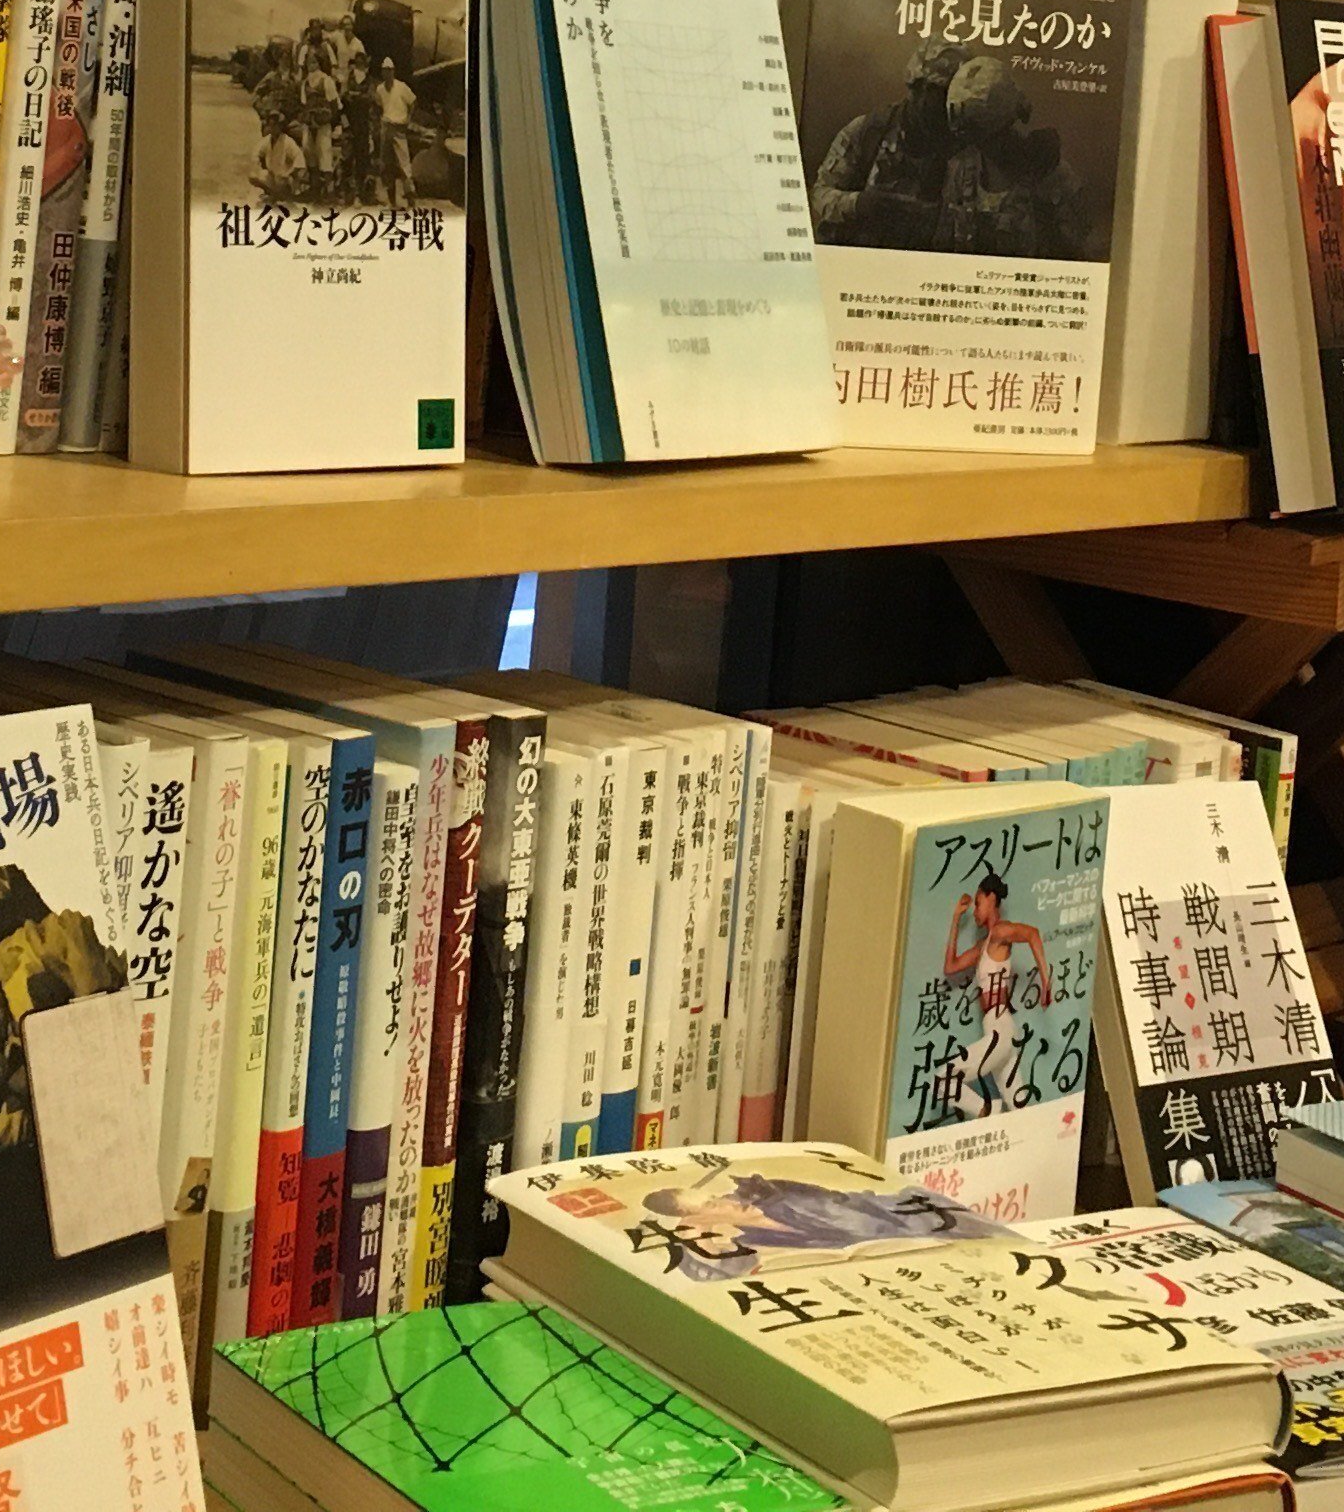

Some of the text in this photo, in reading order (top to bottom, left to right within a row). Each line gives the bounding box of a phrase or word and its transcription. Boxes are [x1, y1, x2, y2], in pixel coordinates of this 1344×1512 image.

[1010, 54, 1108, 77] デイヴィッド・フィンケル
[216, 201, 447, 253] 祖父たちの零戦
[309, 266, 363, 285] 神立尚紀
[38, 232, 76, 396] 田仲康博 編
[832, 362, 1083, 416] 内田樹氏推薦!
[54, 719, 83, 804] 歴史実践
[690, 770, 709, 850] 東京裁判
[721, 744, 743, 864] シベリア抑留
[75, 718, 120, 943] ある日本兵の日記をめぐる
[260, 836, 280, 881] 96歳
[376, 789, 401, 917] 鎌田中将への密命
[501, 735, 544, 952] 幻の大東亜戦争
[562, 797, 585, 892] 東條英機
[635, 768, 659, 866] 東京裁判
[669, 772, 692, 882] 戦争と指揮
[928, 808, 1103, 892] アスリートは
[201, 766, 245, 1013] 「誉れの子」と戦争
[290, 764, 332, 982] 空のかなたに
[382, 782, 420, 1058] 皇室をお護りせよ!
[582, 771, 616, 1019] 石原莞爾の世界戦略構想
[394, 751, 452, 1195] 少年兵はなぜ故郷に火を放ったのか
[912, 950, 1094, 1039] 歳を取るほど
[1180, 881, 1255, 1068] 戦間期
[1245, 879, 1322, 1057] 三木清
[904, 1017, 1085, 1135] 強くなる
[359, 1202, 382, 1260] 鎌田
[1245, 1303, 1332, 1329] 佐藤
